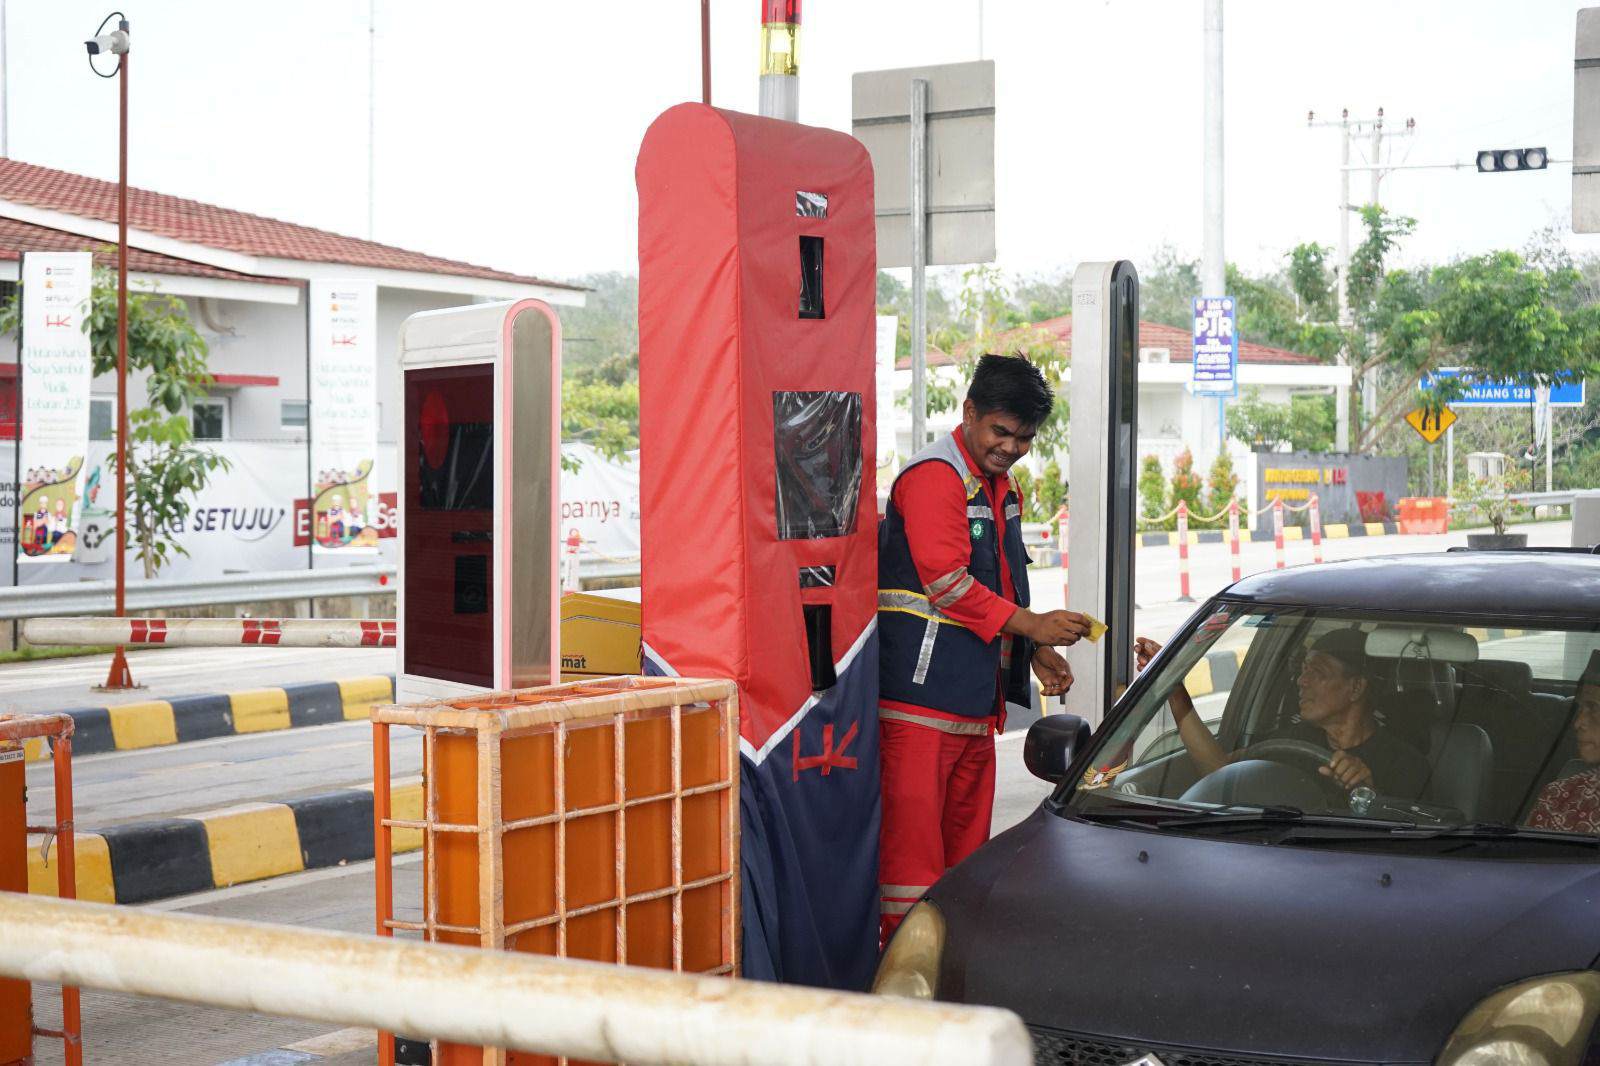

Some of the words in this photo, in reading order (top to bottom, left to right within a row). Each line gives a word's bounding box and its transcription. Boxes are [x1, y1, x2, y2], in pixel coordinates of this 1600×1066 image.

[1195, 317, 1233, 338] PJR
[1459, 387, 1510, 399] ANJANG
[1512, 387, 1531, 399] 128
[193, 508, 274, 532] SETUJU
[561, 656, 587, 669] mat
